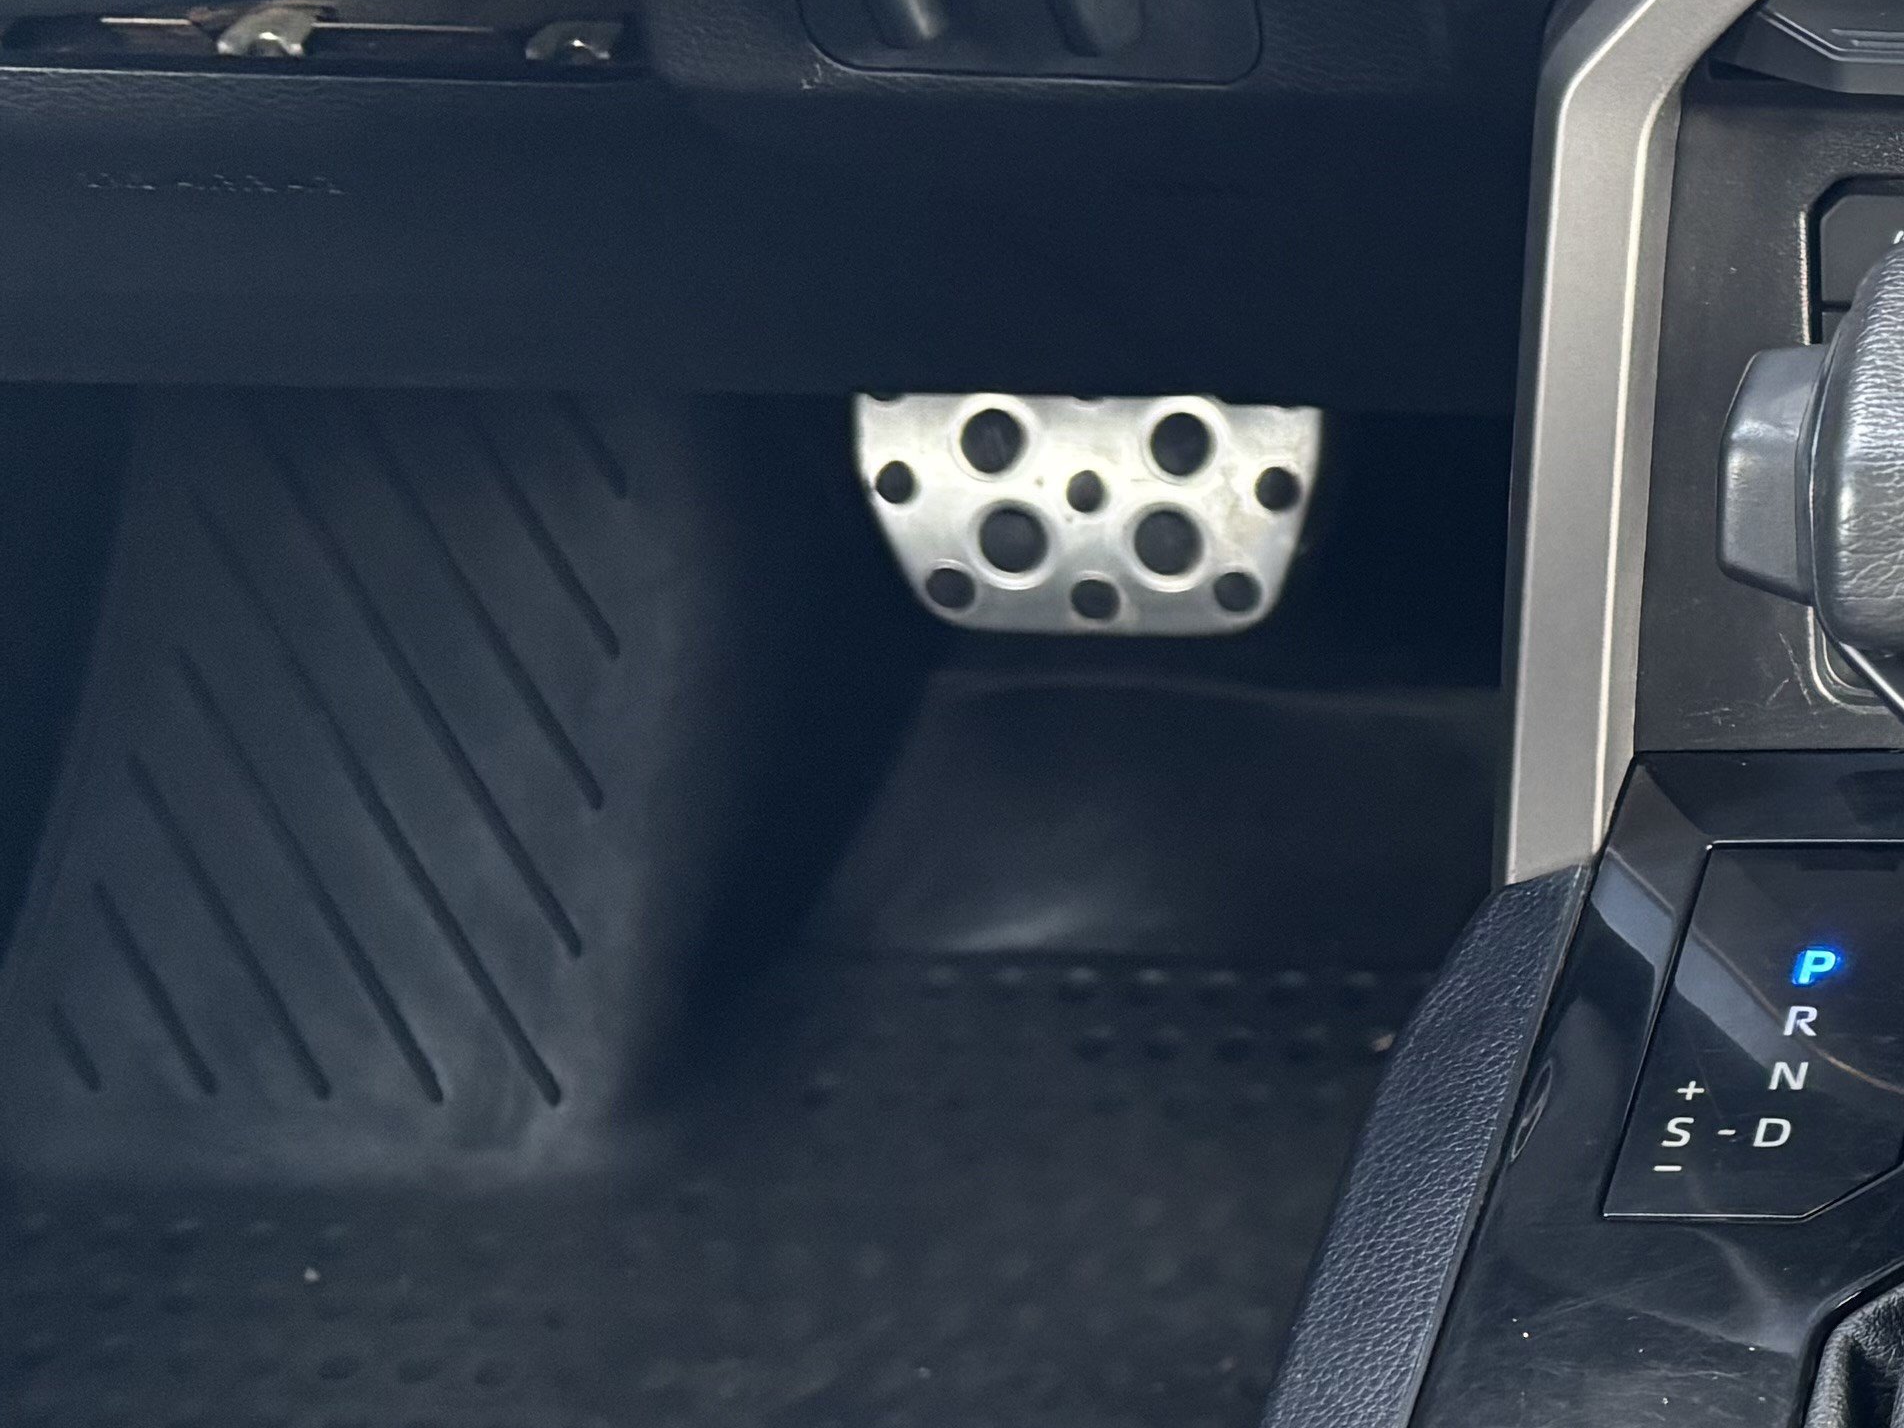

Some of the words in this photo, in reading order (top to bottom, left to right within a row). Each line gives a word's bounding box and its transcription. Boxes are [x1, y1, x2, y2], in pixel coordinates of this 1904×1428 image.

[1793, 948, 1837, 986] P
[1784, 1006, 1817, 1036] R
[1769, 1062, 1808, 1089] N
[1662, 1118, 1694, 1146] S
[1753, 1118, 1791, 1147] D
